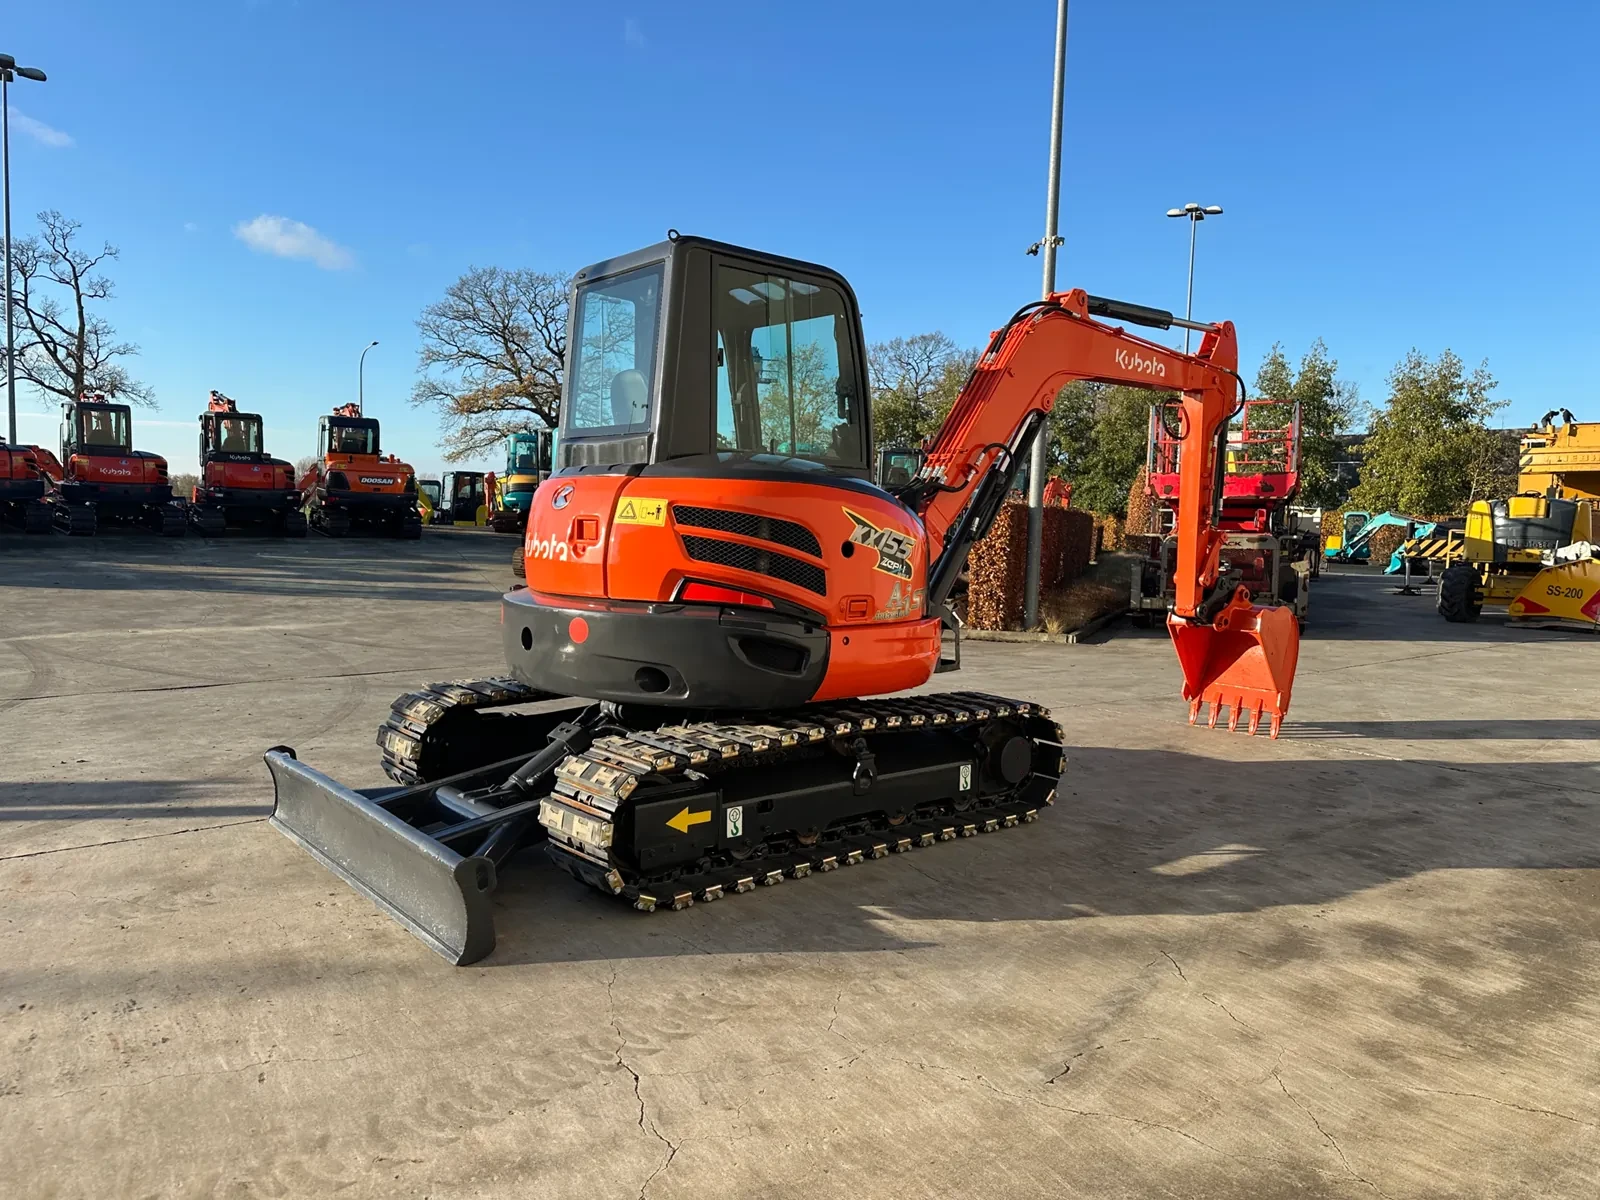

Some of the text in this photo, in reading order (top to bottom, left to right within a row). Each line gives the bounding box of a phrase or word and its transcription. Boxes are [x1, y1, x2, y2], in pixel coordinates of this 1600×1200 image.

[1115, 348, 1166, 377] Kubota
[99, 467, 131, 476] Kubota
[360, 477, 394, 485] DOOSAN
[851, 524, 915, 560] KX155
[1547, 584, 1583, 600] SS-200
